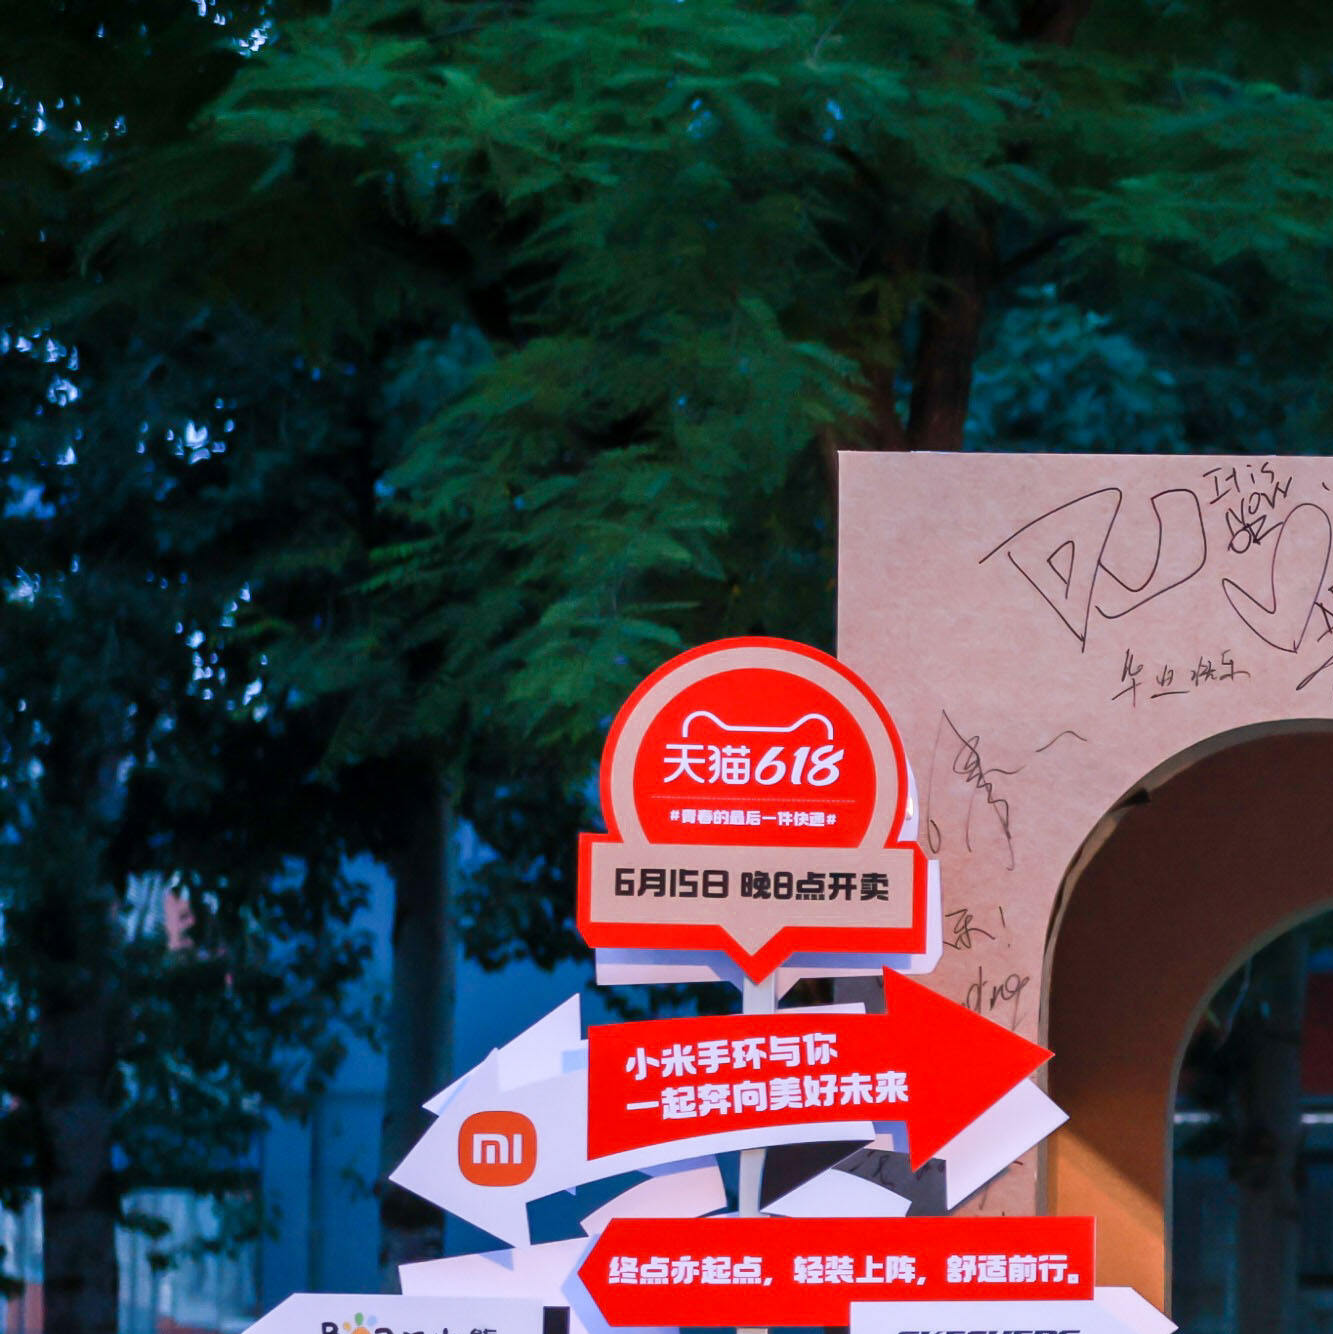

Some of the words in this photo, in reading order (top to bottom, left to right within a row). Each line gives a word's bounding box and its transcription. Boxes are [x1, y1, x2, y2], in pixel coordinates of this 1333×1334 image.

[662, 744, 846, 788] 天猫618
[614, 868, 730, 900] 6月15日
[740, 869, 890, 902] 晚8点开卖
[625, 1032, 838, 1082] 小米手环与你
[625, 1070, 910, 1122] 一起奔向美好未来
